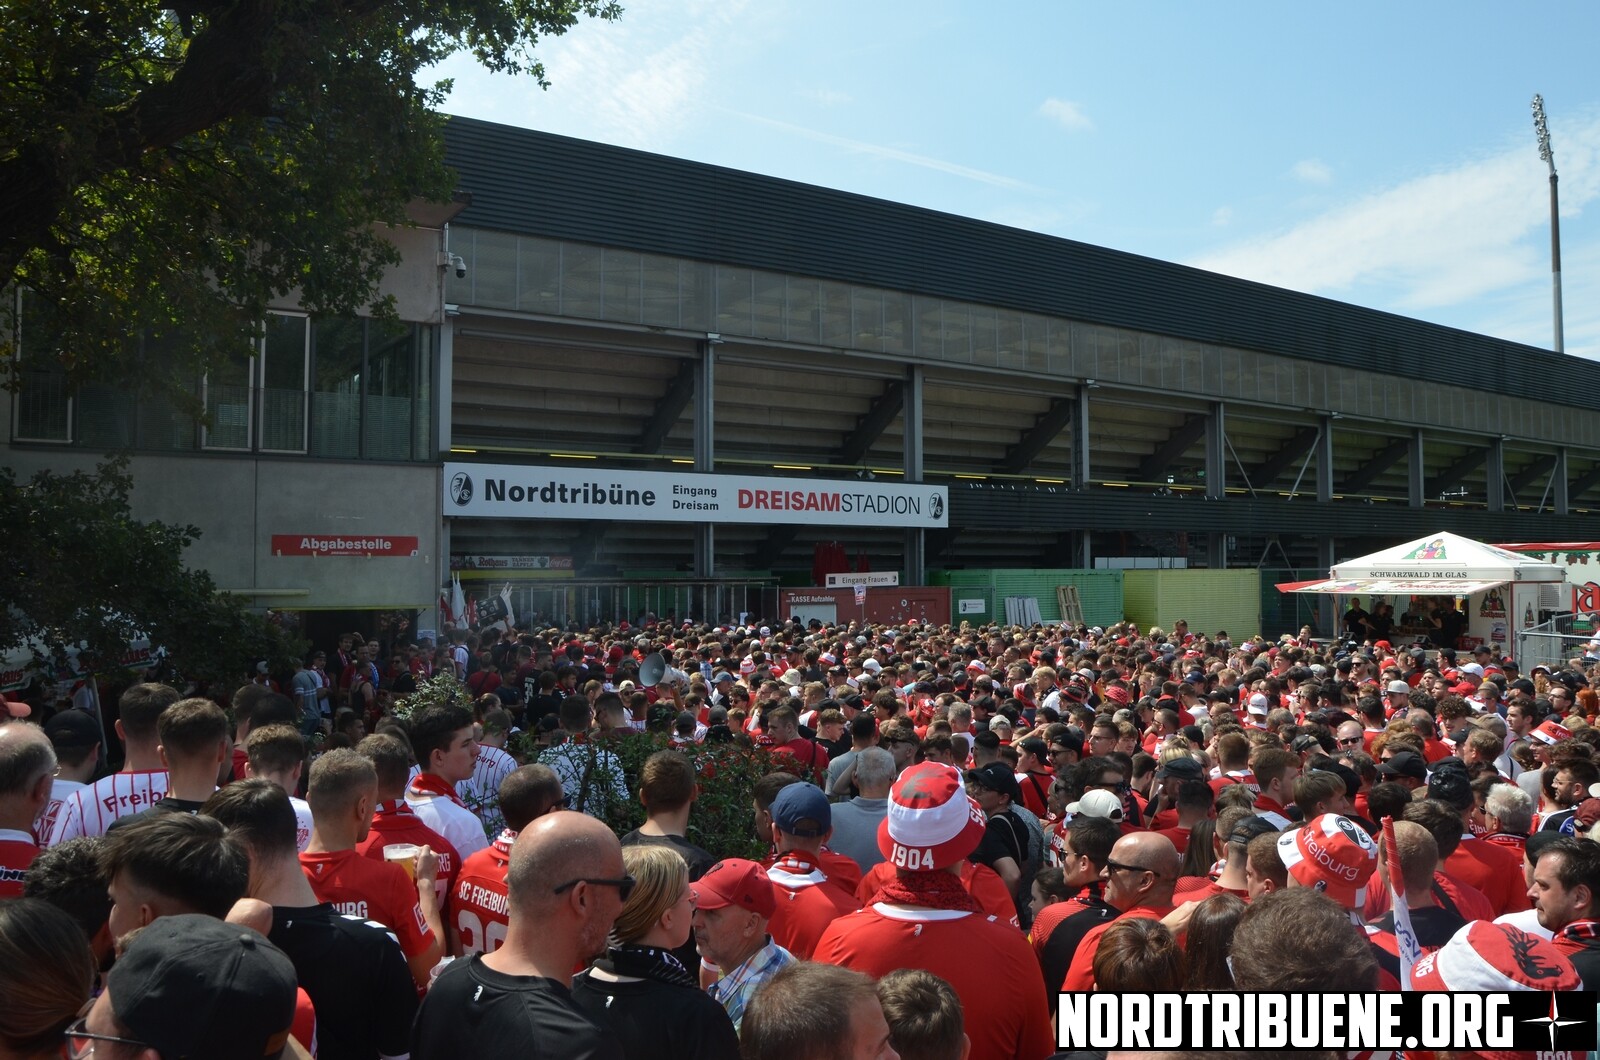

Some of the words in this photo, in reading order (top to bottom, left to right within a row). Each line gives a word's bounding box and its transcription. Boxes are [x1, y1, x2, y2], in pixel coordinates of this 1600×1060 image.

[484, 478, 656, 506] Nordtribüne
[672, 485, 718, 498] Eingang
[672, 500, 719, 511] Dreisam
[300, 537, 392, 552] Abgabestelle
[477, 557, 508, 568] Rothaus
[842, 576, 867, 585] Eingang
[868, 576, 888, 584] Frauen
[1369, 571, 1430, 579] SCHWARZWALD
[1445, 571, 1468, 579] GLAS
[791, 595, 810, 603] KASSE
[890, 842, 934, 870] 1904
[458, 880, 472, 901] SC
